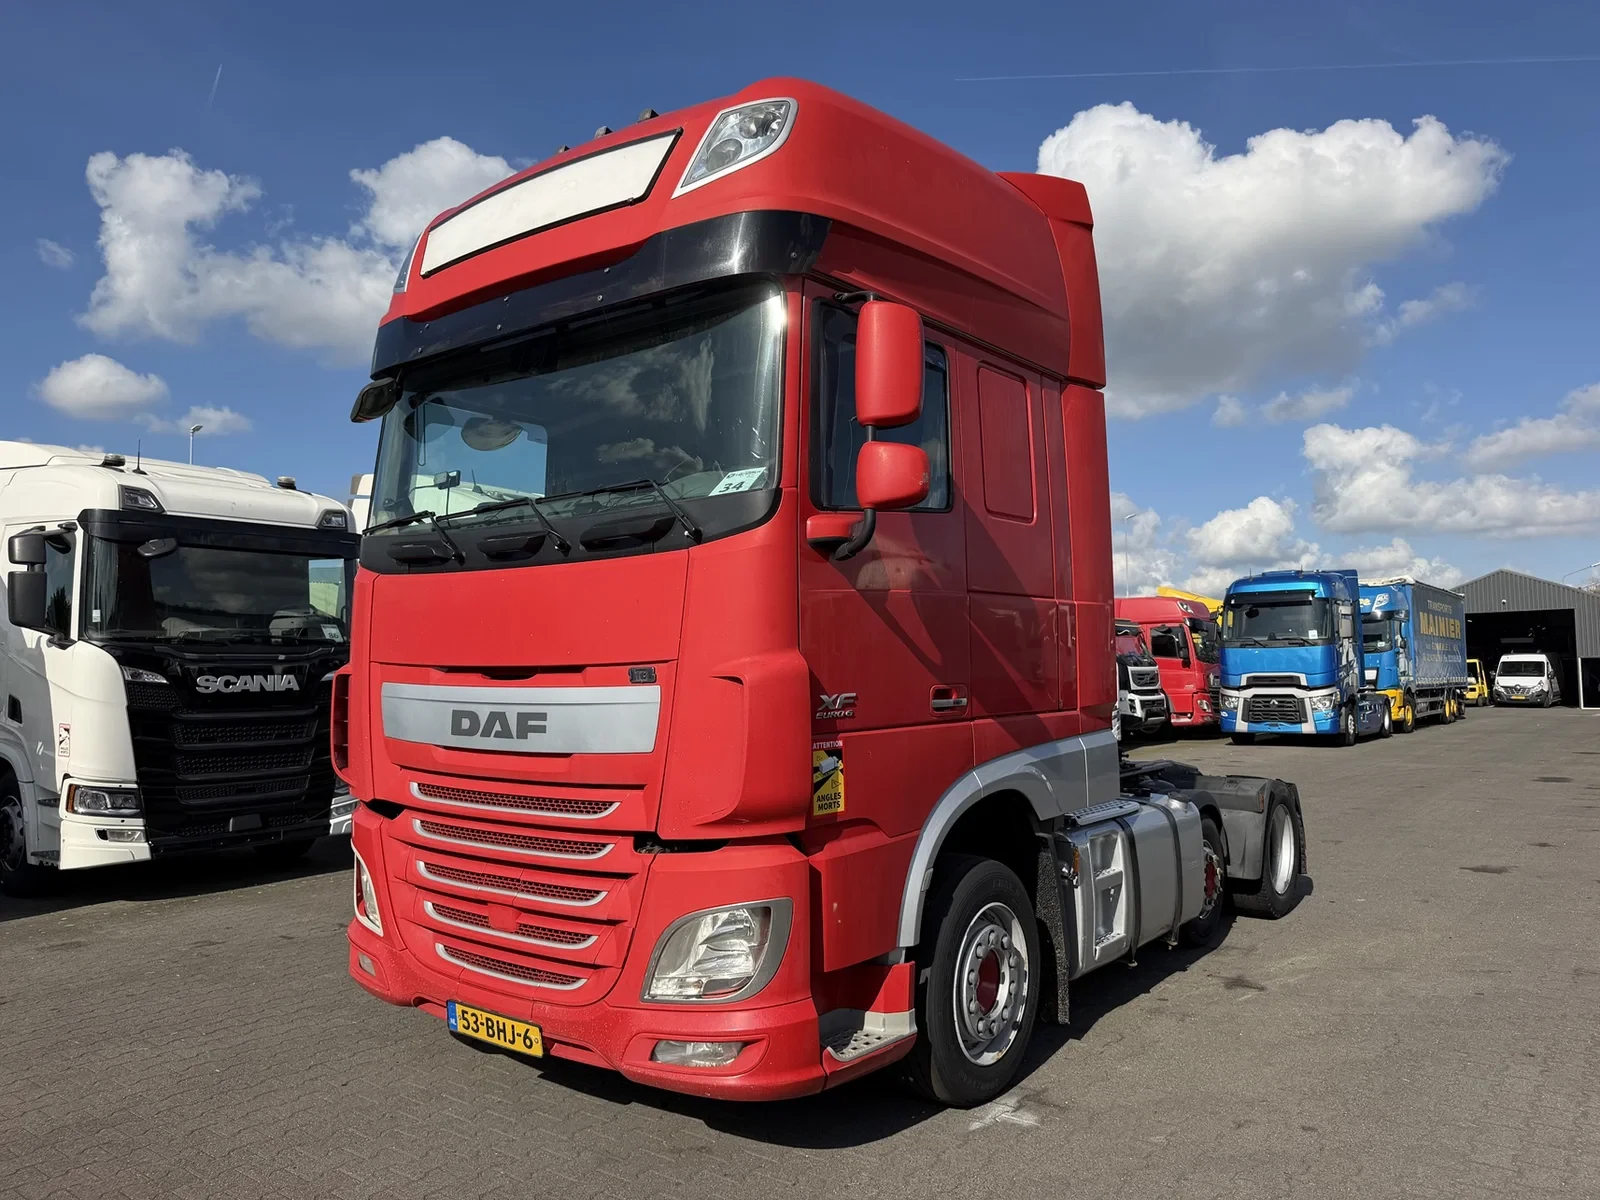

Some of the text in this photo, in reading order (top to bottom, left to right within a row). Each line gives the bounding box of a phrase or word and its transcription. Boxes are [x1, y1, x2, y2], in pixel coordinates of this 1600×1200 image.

[718, 481, 746, 493] 34
[1420, 611, 1461, 640] MAINIER
[196, 674, 300, 693] SCANIA
[817, 693, 857, 711] XF
[816, 709, 854, 719] EURO 6
[450, 709, 548, 740] DAF
[812, 740, 843, 750] ATTENTION
[816, 792, 842, 803] ANGLES
[817, 801, 841, 811] MORTS
[461, 1009, 534, 1049] 53-BHJ-6
